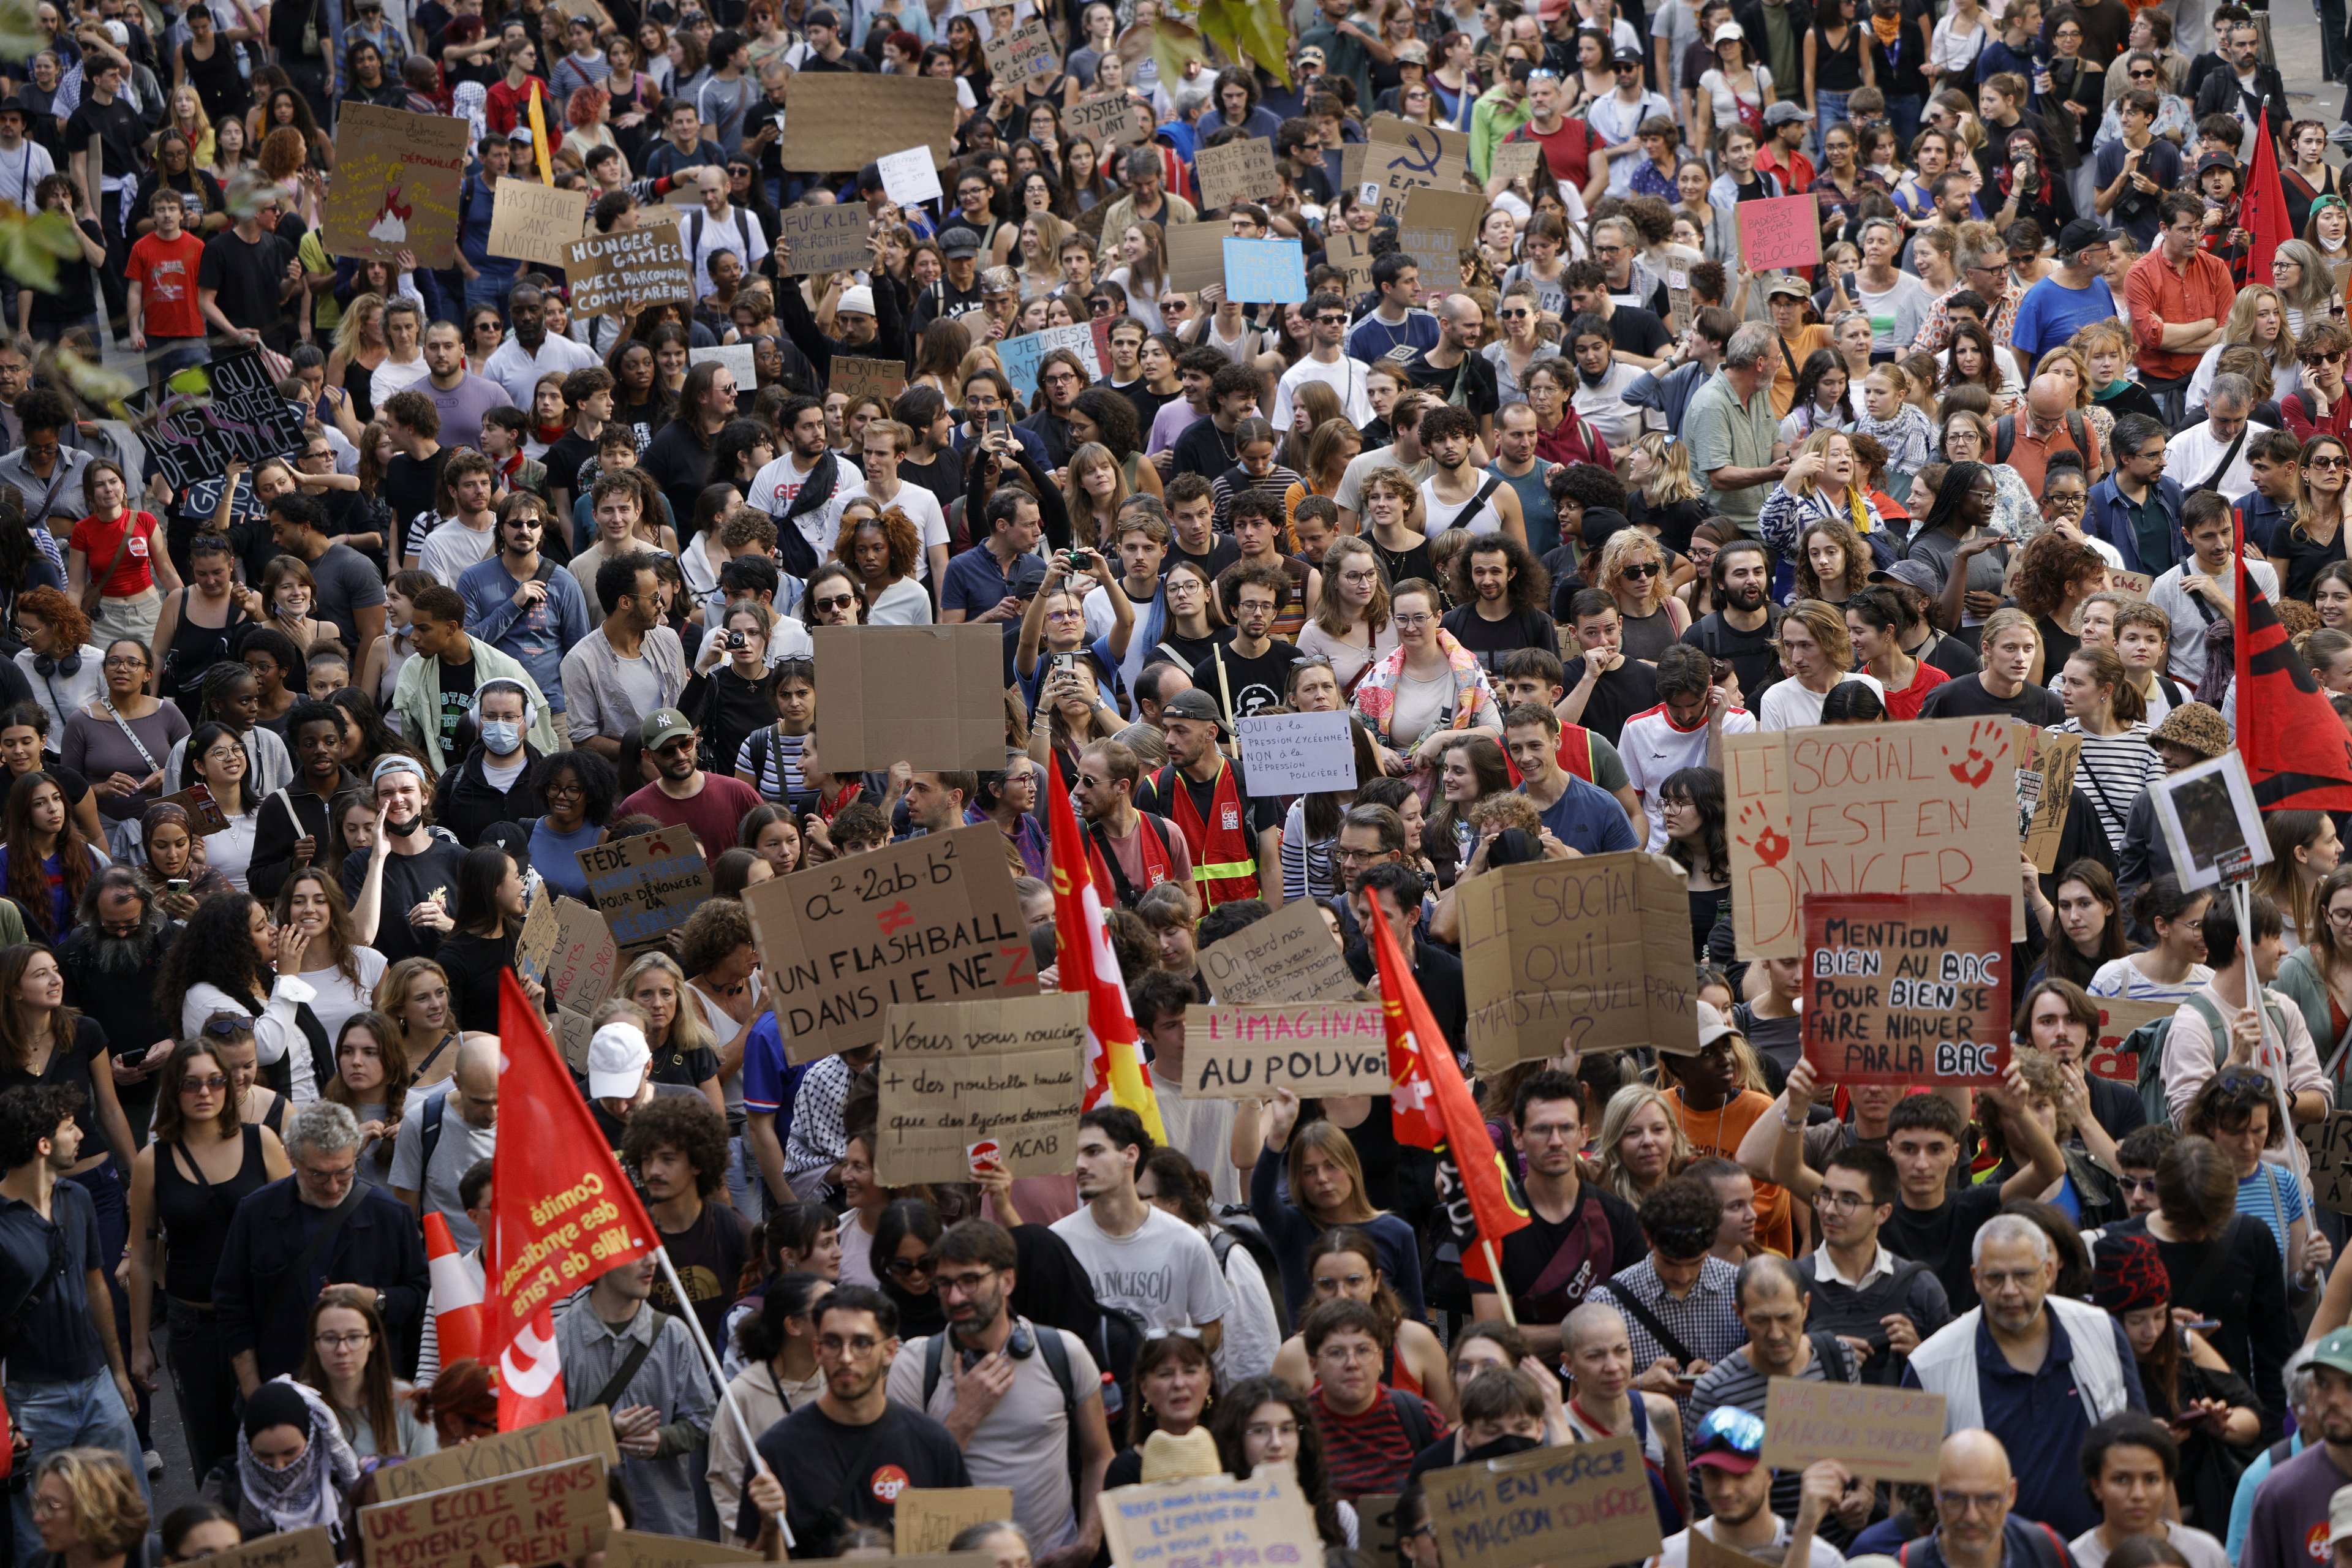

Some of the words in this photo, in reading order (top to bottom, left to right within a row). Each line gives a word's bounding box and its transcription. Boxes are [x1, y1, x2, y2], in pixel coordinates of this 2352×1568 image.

[987, 40, 1005, 53] ON
[1011, 42, 1049, 64] ENVOIE
[1006, 67, 1025, 83] LES
[1027, 55, 1054, 74] CRS
[1197, 145, 1245, 166] RECYCLEZ
[1250, 143, 1268, 154] VOS
[502, 187, 527, 209] PAS
[519, 216, 553, 236] SANS
[785, 213, 834, 233] FUCK
[839, 211, 859, 227] LA
[1747, 208, 1793, 229] BADDEST
[1757, 219, 1793, 237] BITCHES
[570, 230, 654, 263] HUNGER
[1751, 239, 1811, 268] BLOCUS
[1752, 237, 1770, 249] ARE
[1777, 230, 1792, 243] IN
[612, 243, 681, 268] GAMES
[789, 253, 816, 271] VIVE
[572, 273, 619, 297] AVEC
[578, 290, 641, 312] COMME
[642, 279, 690, 301] ARÈNE
[215, 355, 266, 395] QUI
[835, 359, 895, 378] HONTE
[840, 382, 881, 397] VOUS
[141, 410, 205, 455] NOUS
[156, 446, 200, 489] DE
[191, 435, 222, 477] LA
[217, 412, 303, 470] POLICE
[657, 713, 673, 728] NY
[1241, 718, 1267, 736] OUI
[1276, 722, 1284, 733] à
[1289, 720, 1304, 731] la
[1246, 750, 1272, 762] NON
[1280, 750, 1287, 760] à
[1291, 748, 1304, 756] la
[1248, 736, 1292, 747] PRESSION
[1253, 761, 1306, 772] RÉPRESSION
[1289, 768, 1338, 780] POLICIÈRE
[1733, 745, 1783, 799] LE
[1792, 736, 1936, 795] SOCIAL
[1221, 812, 1238, 821] cgt
[1804, 799, 1899, 847] EST
[1915, 797, 1971, 839] EN
[581, 841, 631, 873] FÉDÉ
[598, 892, 633, 910] POUR
[636, 874, 703, 902] DÉNONCER
[645, 895, 666, 911] LA
[1461, 881, 1515, 949] LE
[1531, 867, 1649, 927] SOCIAL
[552, 923, 570, 956] DES
[1824, 916, 1949, 948] MENTION
[774, 960, 820, 996] UN
[829, 913, 1018, 979] FLASHBALL
[1208, 951, 1240, 979] On
[1245, 932, 1278, 973] perd
[1281, 925, 1305, 945] nos
[1262, 959, 1283, 976] nos
[1287, 967, 1305, 982] nos
[1305, 951, 1339, 973] mains
[1813, 944, 1882, 978] BIEN
[1894, 953, 1929, 978] AU
[1939, 951, 2002, 987] BAC
[552, 943, 586, 1001] DROITS
[572, 978, 601, 1014] DES
[789, 986, 878, 1037] DANS
[948, 944, 1038, 996] NEZ
[1814, 979, 1879, 1010] POUR
[1888, 977, 1958, 1011] BIEN
[1959, 987, 1991, 1012] SE
[1475, 990, 1530, 1041] MAIS
[1566, 980, 1642, 1015] QUEL
[1643, 974, 1689, 1016] PRIX
[891, 1021, 954, 1052] Vous
[963, 1033, 1017, 1050] vous
[1569, 1014, 1594, 1054] ?
[1885, 1012, 1973, 1045] NIQUER
[1198, 1058, 1253, 1091] AU
[1264, 1051, 1387, 1084] POUVOI
[1934, 1041, 1999, 1076] BAC
[912, 1069, 945, 1094] des
[890, 1114, 926, 1145] que
[938, 1113, 965, 1128] des
[967, 1112, 1017, 1135] lycéens
[1009, 1134, 1058, 1159] ACAB
[388, 1461, 446, 1499] PAS
[873, 1477, 905, 1500] cgt
[1496, 1474, 1539, 1504] EN
[1542, 1450, 1625, 1487] FORCE
[368, 1503, 417, 1541] UNE
[527, 1463, 597, 1504] SANS
[535, 1499, 572, 1530] NE
[503, 1531, 568, 1564] RIEN
[1452, 1506, 1554, 1559] MACRON
[2309, 1539, 2333, 1561] cg
